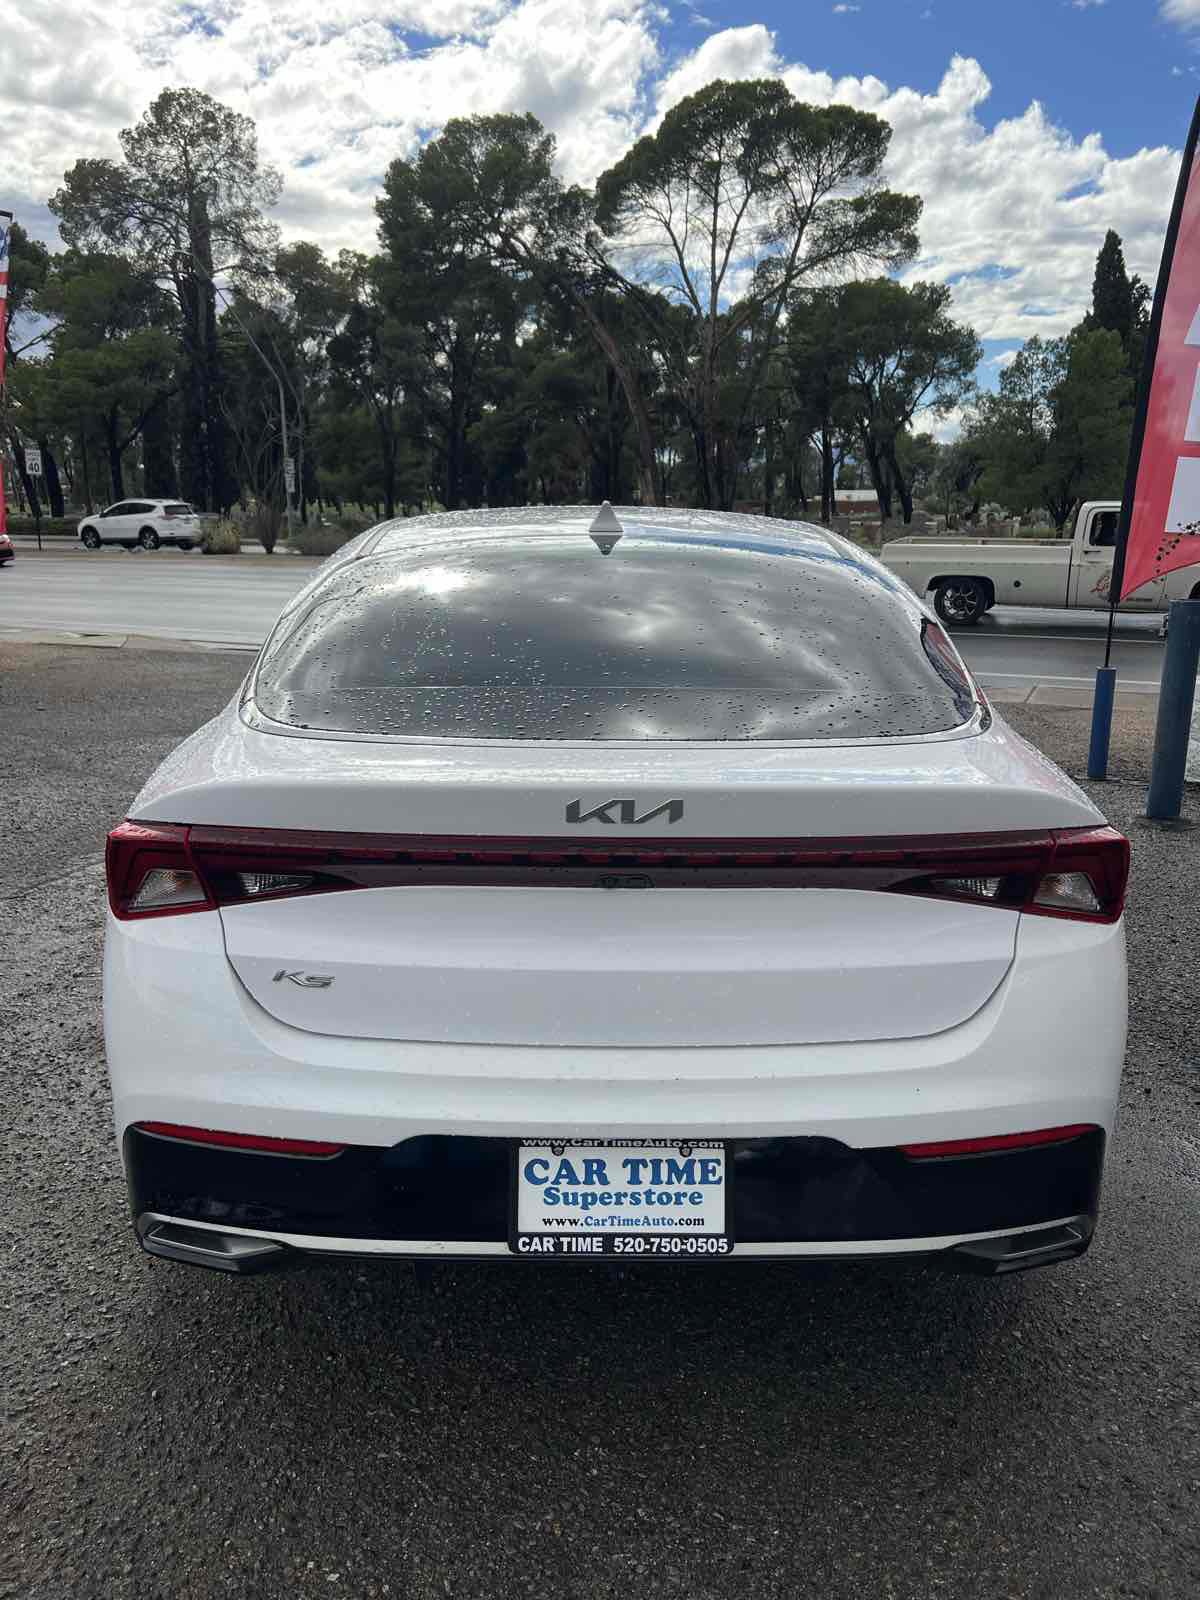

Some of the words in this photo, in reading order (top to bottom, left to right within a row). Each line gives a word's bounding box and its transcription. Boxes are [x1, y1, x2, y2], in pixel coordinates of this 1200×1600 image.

[28, 463, 40, 473] 40
[566, 799, 683, 824] KIA
[272, 969, 335, 989] K5
[522, 1137, 724, 1149] www.CarTimeAuto.com
[524, 1158, 610, 1186] CAR
[622, 1158, 722, 1186] TIME
[543, 1186, 704, 1210] Superstore
[542, 1215, 705, 1228] www.CarTimeAuto.com
[518, 1237, 556, 1253] CAR
[562, 1237, 603, 1252] TIME
[613, 1237, 729, 1253] 520-750-0505
